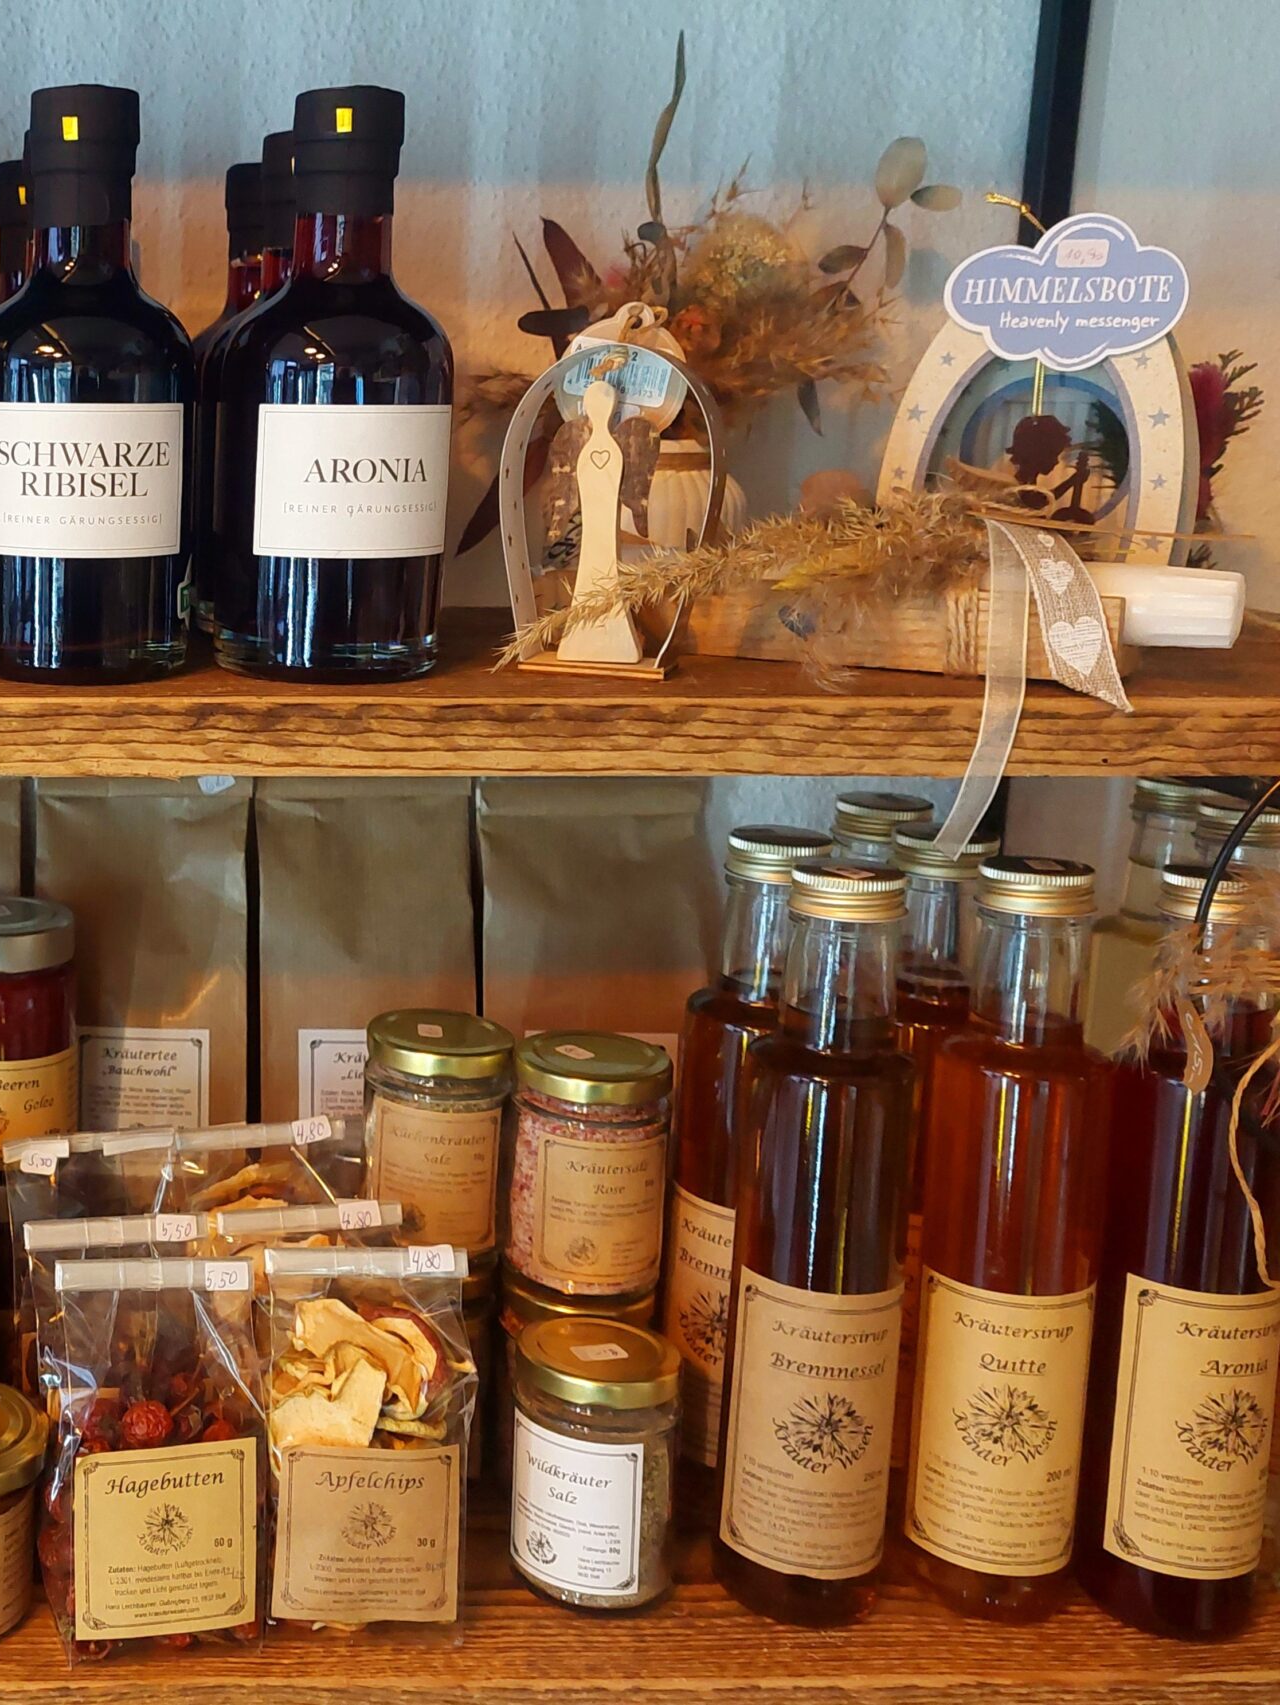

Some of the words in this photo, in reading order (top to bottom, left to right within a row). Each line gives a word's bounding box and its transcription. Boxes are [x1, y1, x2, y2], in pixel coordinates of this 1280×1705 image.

[961, 275, 1174, 305] HIMMELSBOTE
[1000, 311, 1070, 334] Heavenly
[1075, 314, 1160, 333] messenger
[304, 457, 428, 483] ARONIA
[20, 472, 148, 498] RIBISEL
[101, 1047, 177, 1061] Kräutertee
[423, 1154, 452, 1166] Salz
[593, 1183, 626, 1195] Rose
[771, 1319, 888, 1345] Kräutersirup
[953, 1310, 1074, 1342] Kräutersirup
[770, 1351, 887, 1381] Brennnessel
[978, 1352, 1047, 1375] Quitte
[772, 1415, 832, 1475] Kräuter
[832, 1421, 875, 1473] Wesen
[315, 1469, 425, 1494] Apfelchips
[525, 1450, 613, 1489] Wildkräuter
[104, 1470, 225, 1499] Hagebutten
[548, 1486, 578, 1506] Salz
